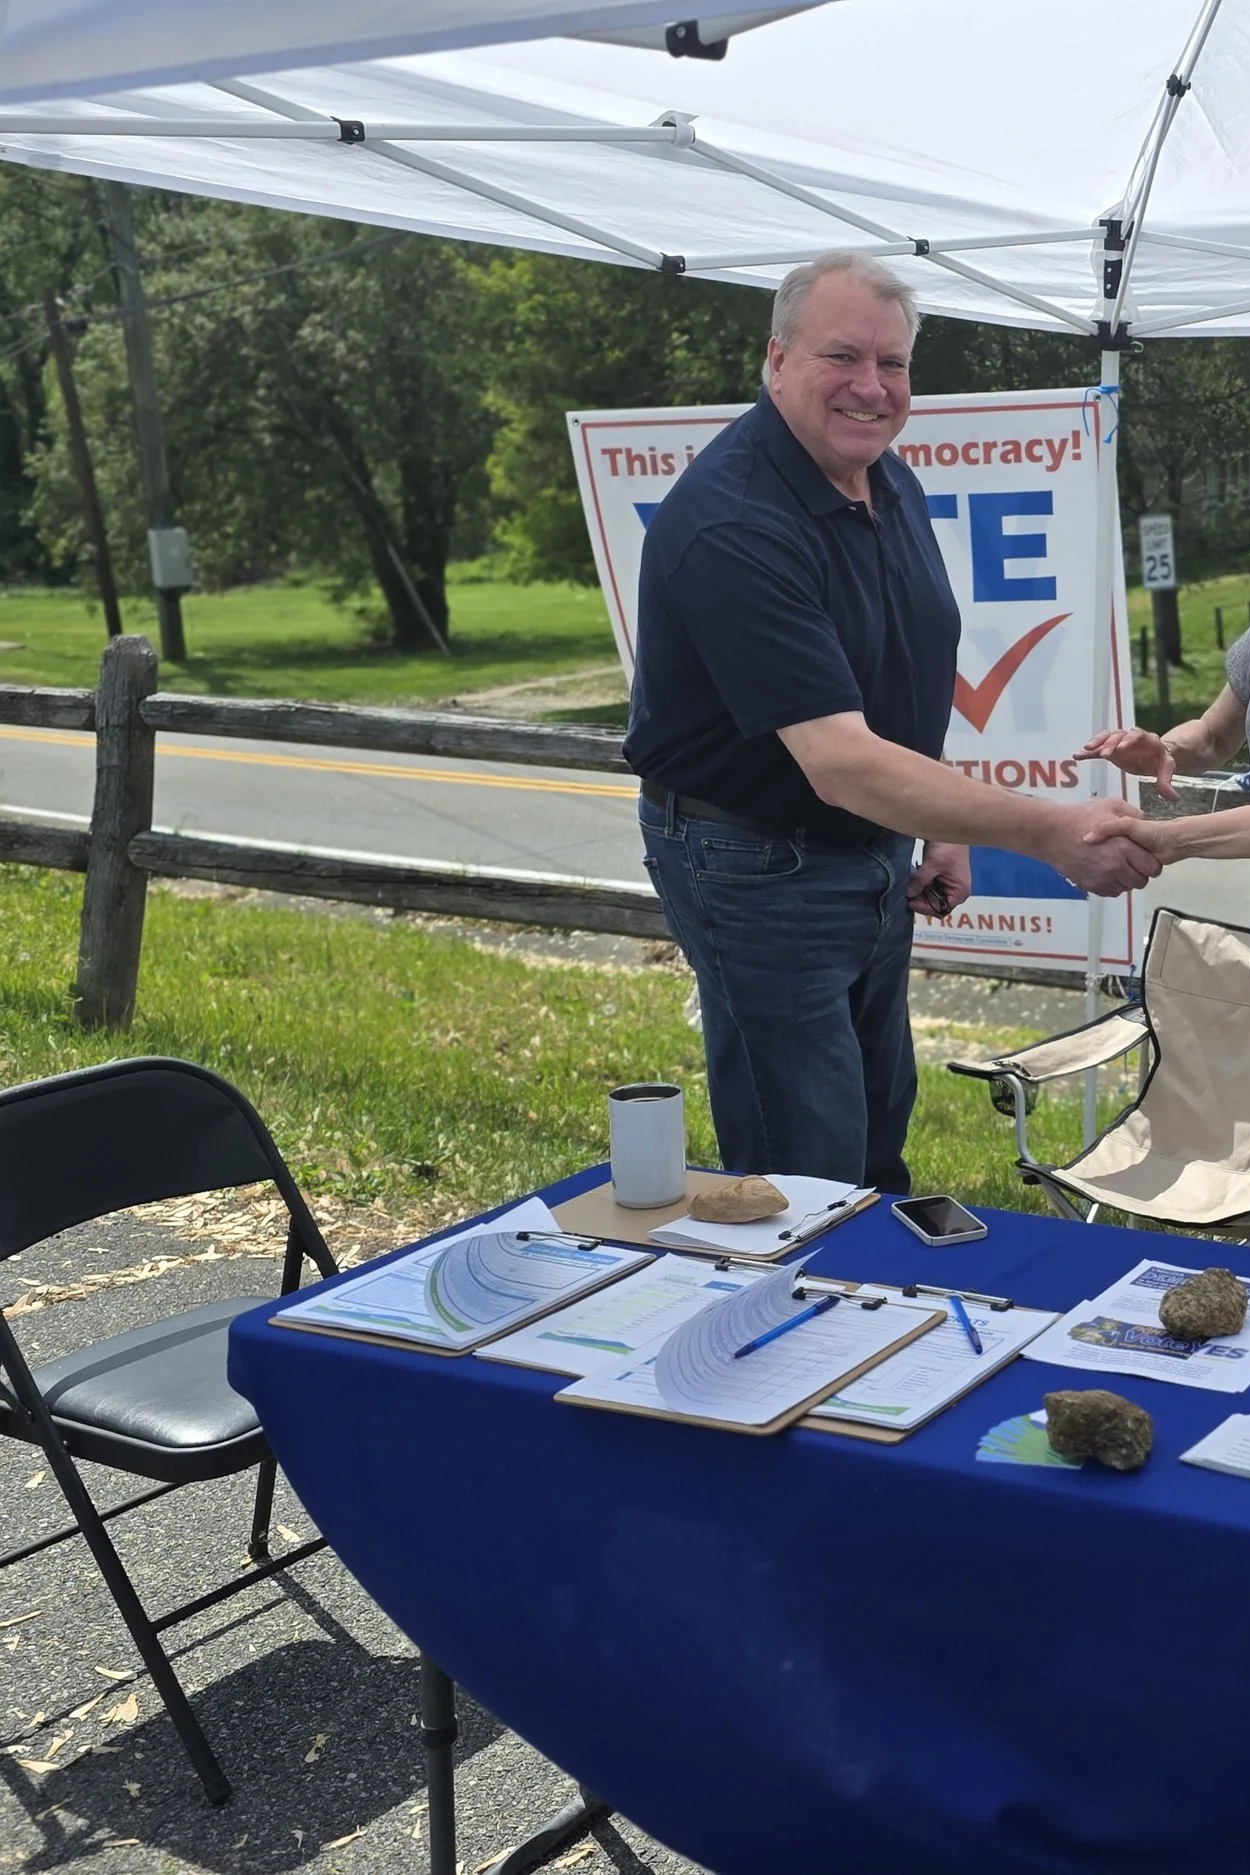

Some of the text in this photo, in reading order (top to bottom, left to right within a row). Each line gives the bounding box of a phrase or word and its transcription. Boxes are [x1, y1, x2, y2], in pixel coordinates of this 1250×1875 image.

[601, 446, 676, 477] This
[897, 430, 1082, 472] mocracy!
[1146, 553, 1171, 581] 25
[946, 759, 1079, 789] TIONS
